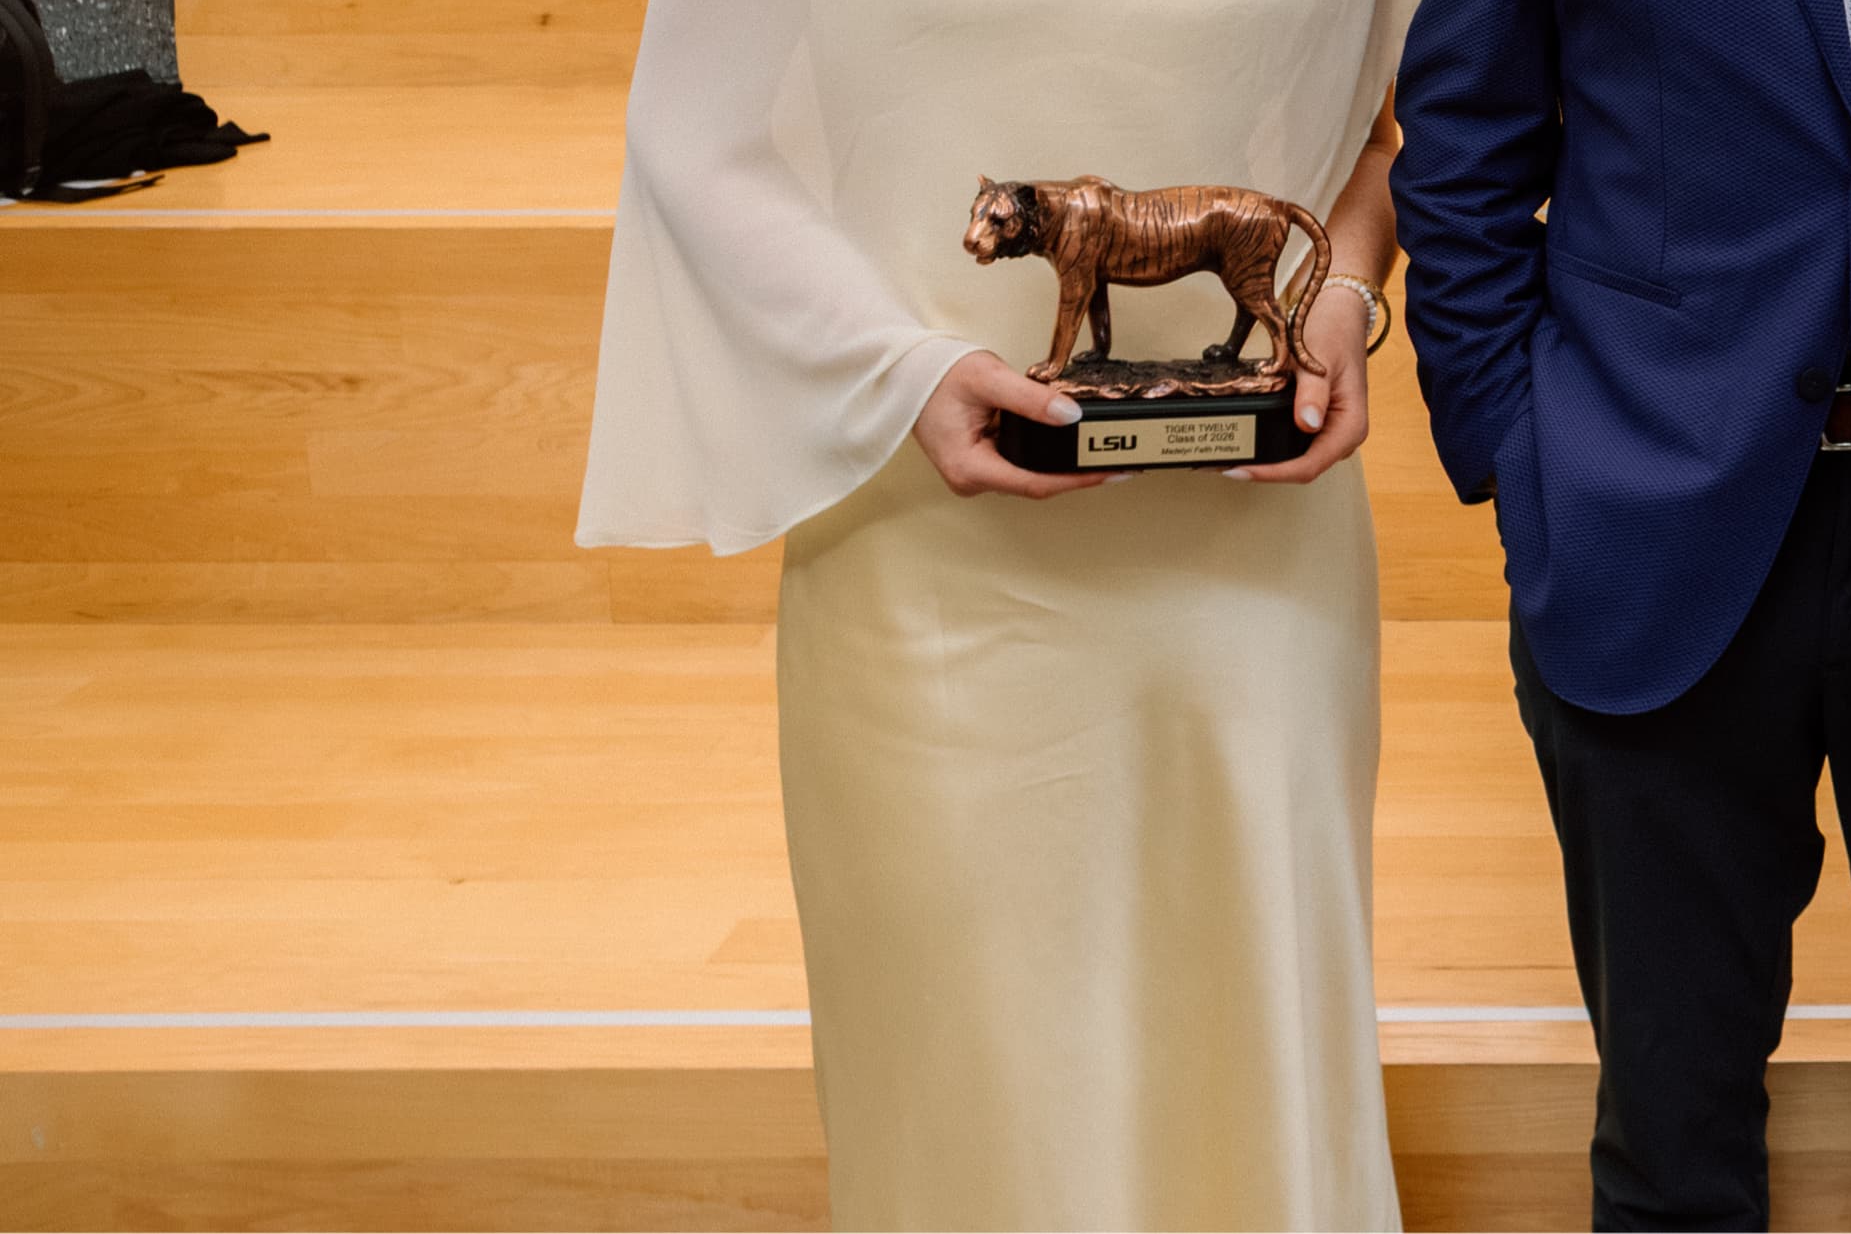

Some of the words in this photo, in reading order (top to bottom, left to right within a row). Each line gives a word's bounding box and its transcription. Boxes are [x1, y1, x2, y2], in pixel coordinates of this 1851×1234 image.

[1165, 424, 1196, 434] TIGER
[1198, 422, 1239, 433] TWELVE
[1088, 435, 1137, 452] LSU
[1168, 434, 1195, 444] Class
[1198, 433, 1208, 443] of
[1210, 432, 1235, 442] 2026
